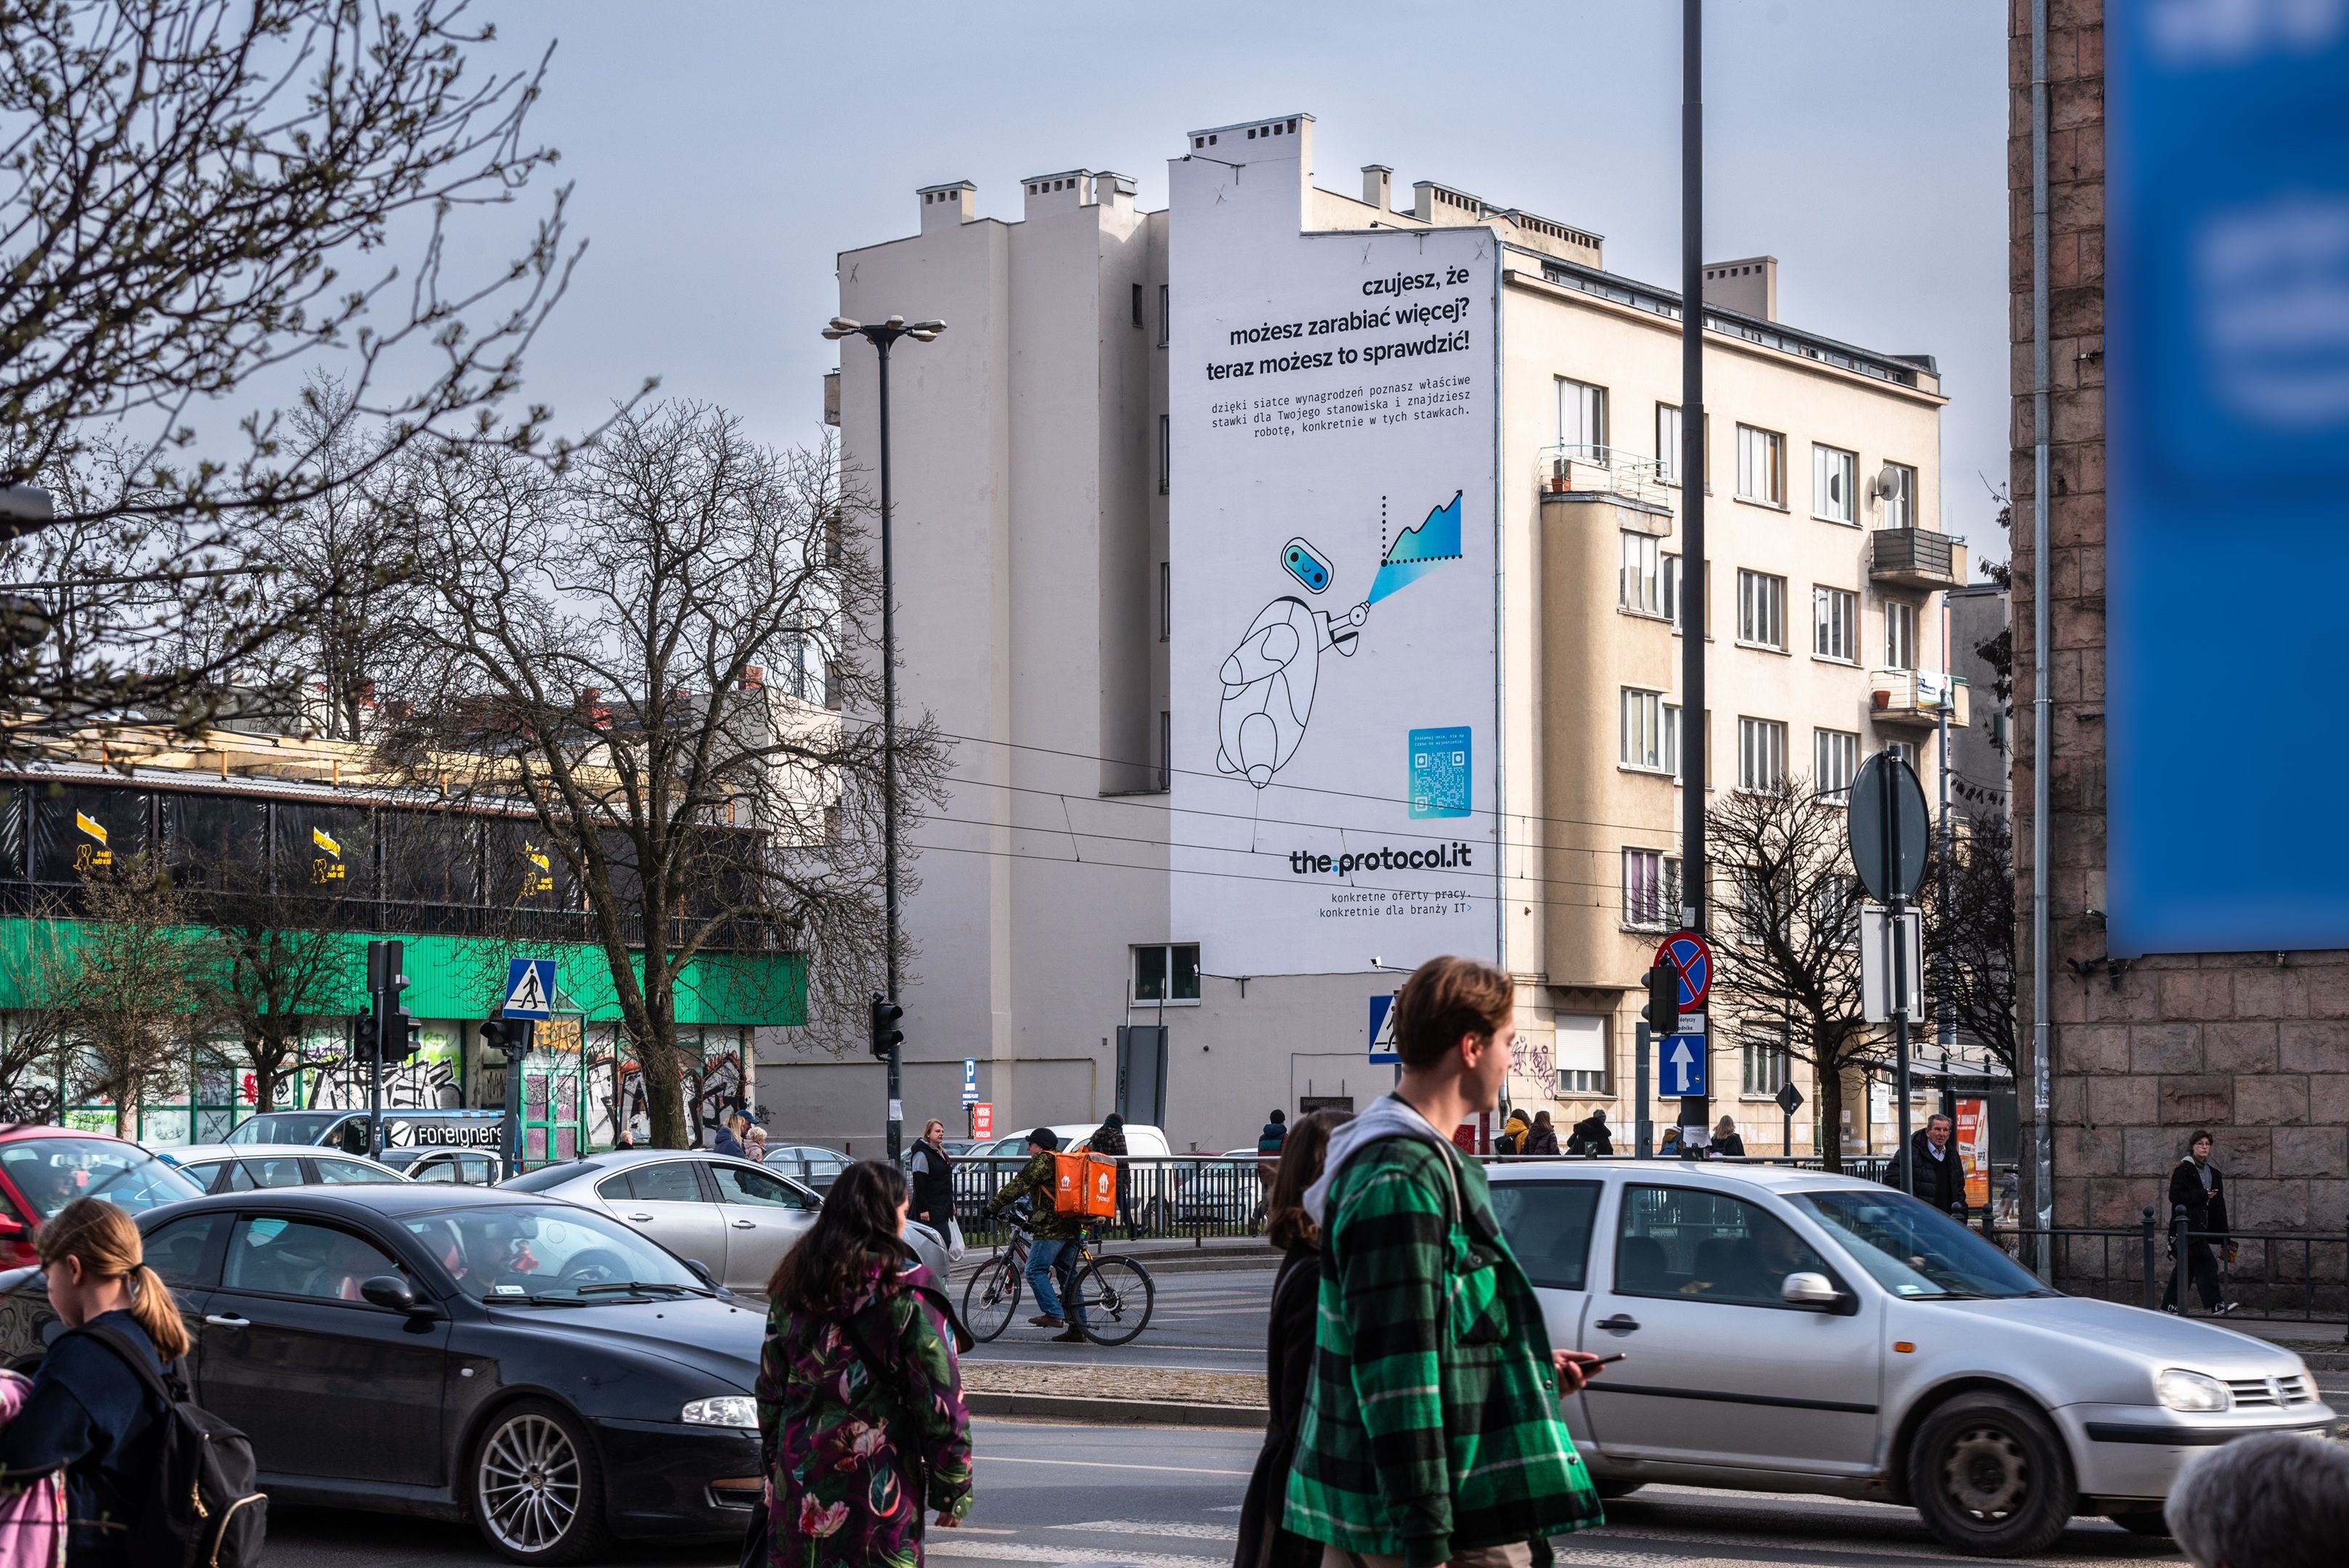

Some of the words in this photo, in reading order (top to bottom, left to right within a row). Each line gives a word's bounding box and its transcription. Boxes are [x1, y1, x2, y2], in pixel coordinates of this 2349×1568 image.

[1362, 269, 1441, 298] czujesz,
[1446, 265, 1470, 286] że
[1230, 322, 1303, 346] możesz
[1308, 306, 1391, 336] zarabiać
[1395, 297, 1470, 327] więcej?
[1206, 361, 1255, 381] teraz
[1259, 351, 1333, 375] możesz
[1338, 346, 1359, 365] to
[1363, 330, 1470, 366] sprawdzić!
[1211, 399, 1247, 416] dzięki
[1253, 397, 1290, 409] siatce
[1295, 386, 1364, 406] wynagrodzeń
[1369, 383, 1413, 399] poznasz
[1419, 375, 1470, 390] właściwe
[1212, 414, 1247, 428] stawki
[1253, 412, 1271, 423] dla
[1277, 408, 1320, 421] Twojego
[1327, 399, 1388, 415] stanowiska
[1395, 396, 1401, 407] i
[1407, 391, 1470, 407] znajdziesz
[1254, 425, 1295, 438] robotę,
[1302, 419, 1364, 433] konkretnie
[1369, 417, 1377, 425] w
[1383, 411, 1407, 425] tych
[1414, 405, 1470, 420] stawkach.
[1332, 892, 1386, 903] konkretne
[1391, 891, 1429, 901] oferty
[1435, 890, 1471, 901] pracy.
[1385, 905, 1404, 916] dla
[1410, 903, 1448, 916] branży
[966, 1061, 974, 1082] P
